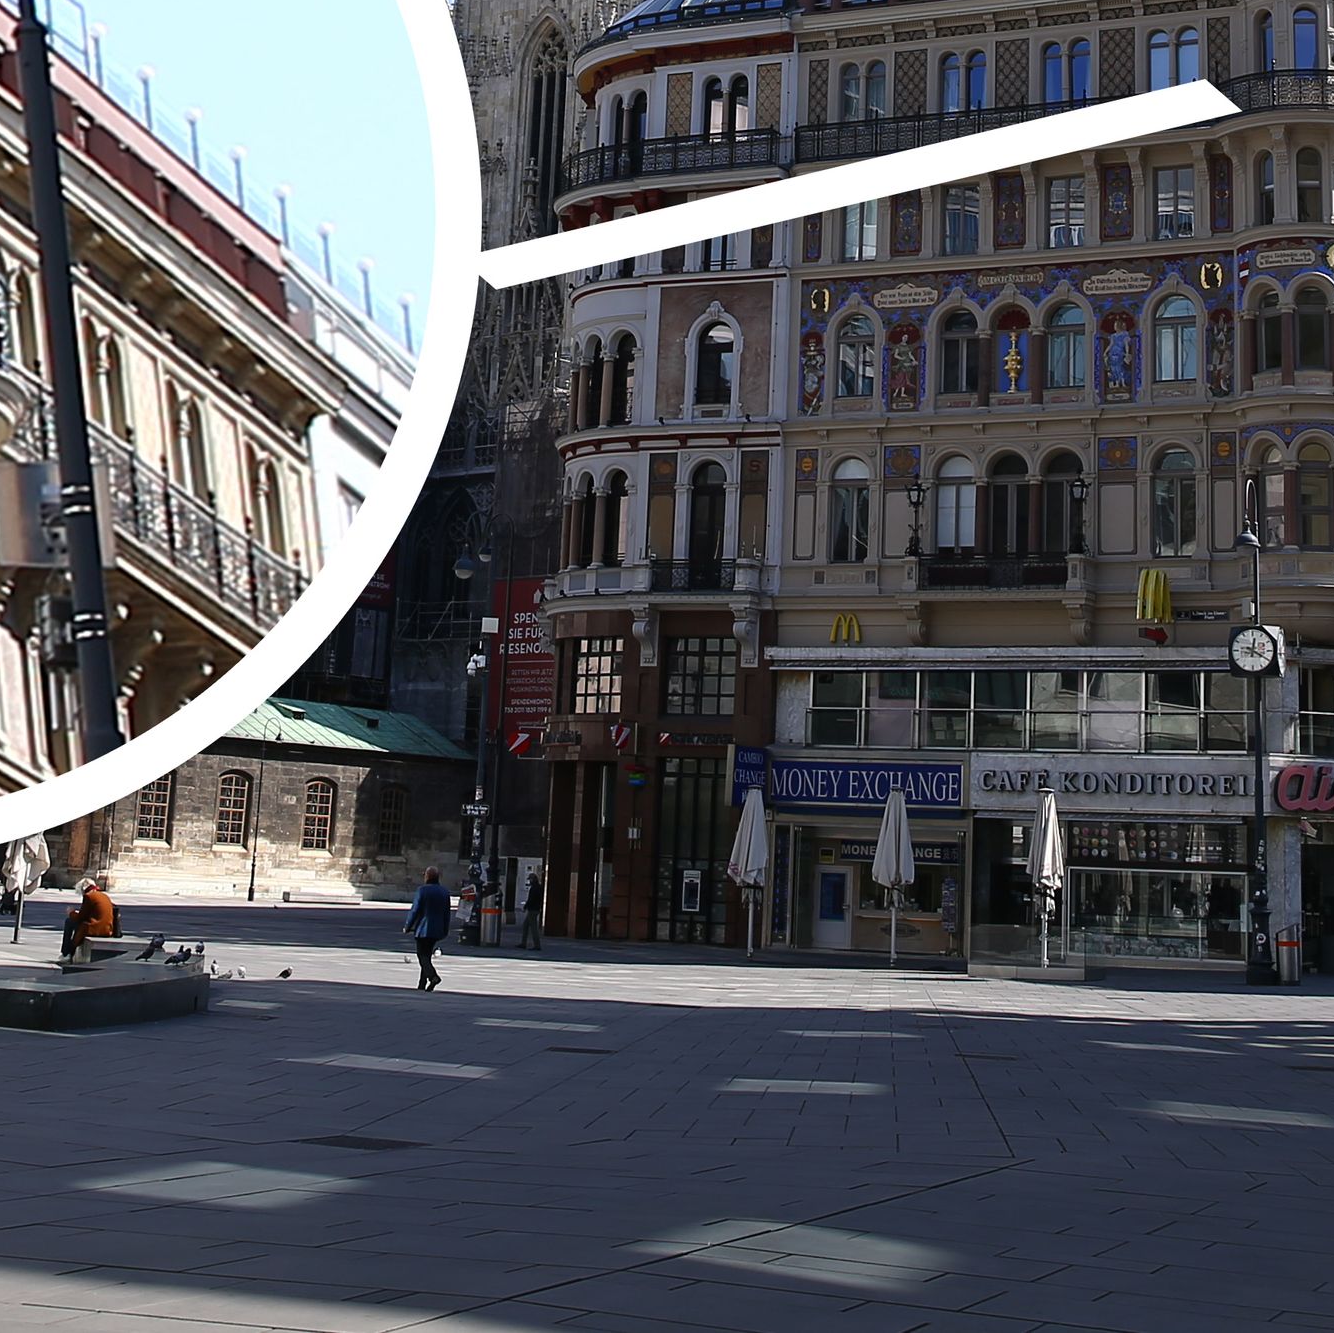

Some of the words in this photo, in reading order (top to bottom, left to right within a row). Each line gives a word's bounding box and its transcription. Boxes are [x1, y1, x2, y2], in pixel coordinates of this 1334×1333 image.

[508, 627, 524, 639] SIE
[525, 623, 545, 639] FÜR
[738, 750, 764, 765] CAMBIO
[733, 768, 766, 786] CHANGE
[771, 768, 842, 799] MONEY
[848, 770, 960, 803] EXCHANGE
[840, 844, 877, 856] MONE
